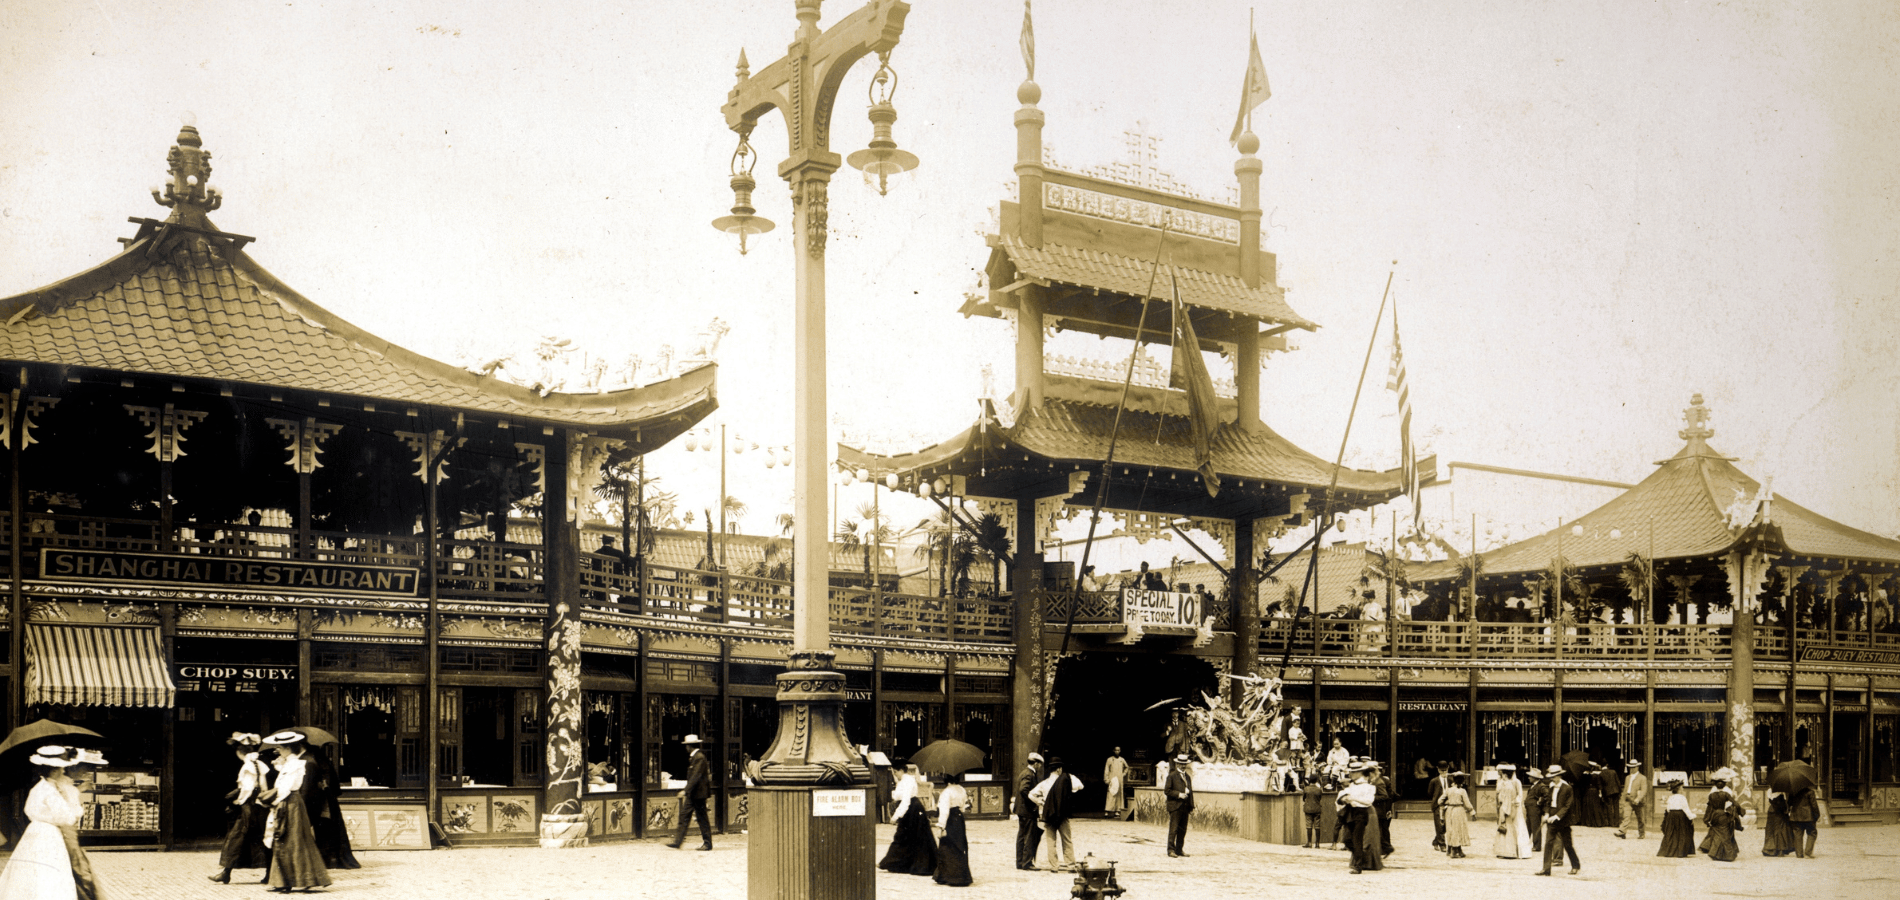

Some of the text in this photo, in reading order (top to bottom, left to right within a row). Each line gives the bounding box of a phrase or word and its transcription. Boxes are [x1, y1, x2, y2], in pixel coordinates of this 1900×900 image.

[1047, 186, 1238, 242] CHINESE VILLAGE
[55, 554, 412, 590] SHANGHAI RESTAURANT
[1126, 589, 1174, 609] SPECIAL
[1126, 608, 1177, 624] PRE TODAY.
[1805, 648, 1831, 660] CHOP
[1831, 649, 1857, 661] SUEY
[180, 666, 295, 680] CHOP SUEY.
[1398, 703, 1468, 711] RESTAURANT
[816, 795, 861, 803] FIRE ALARM BOX
